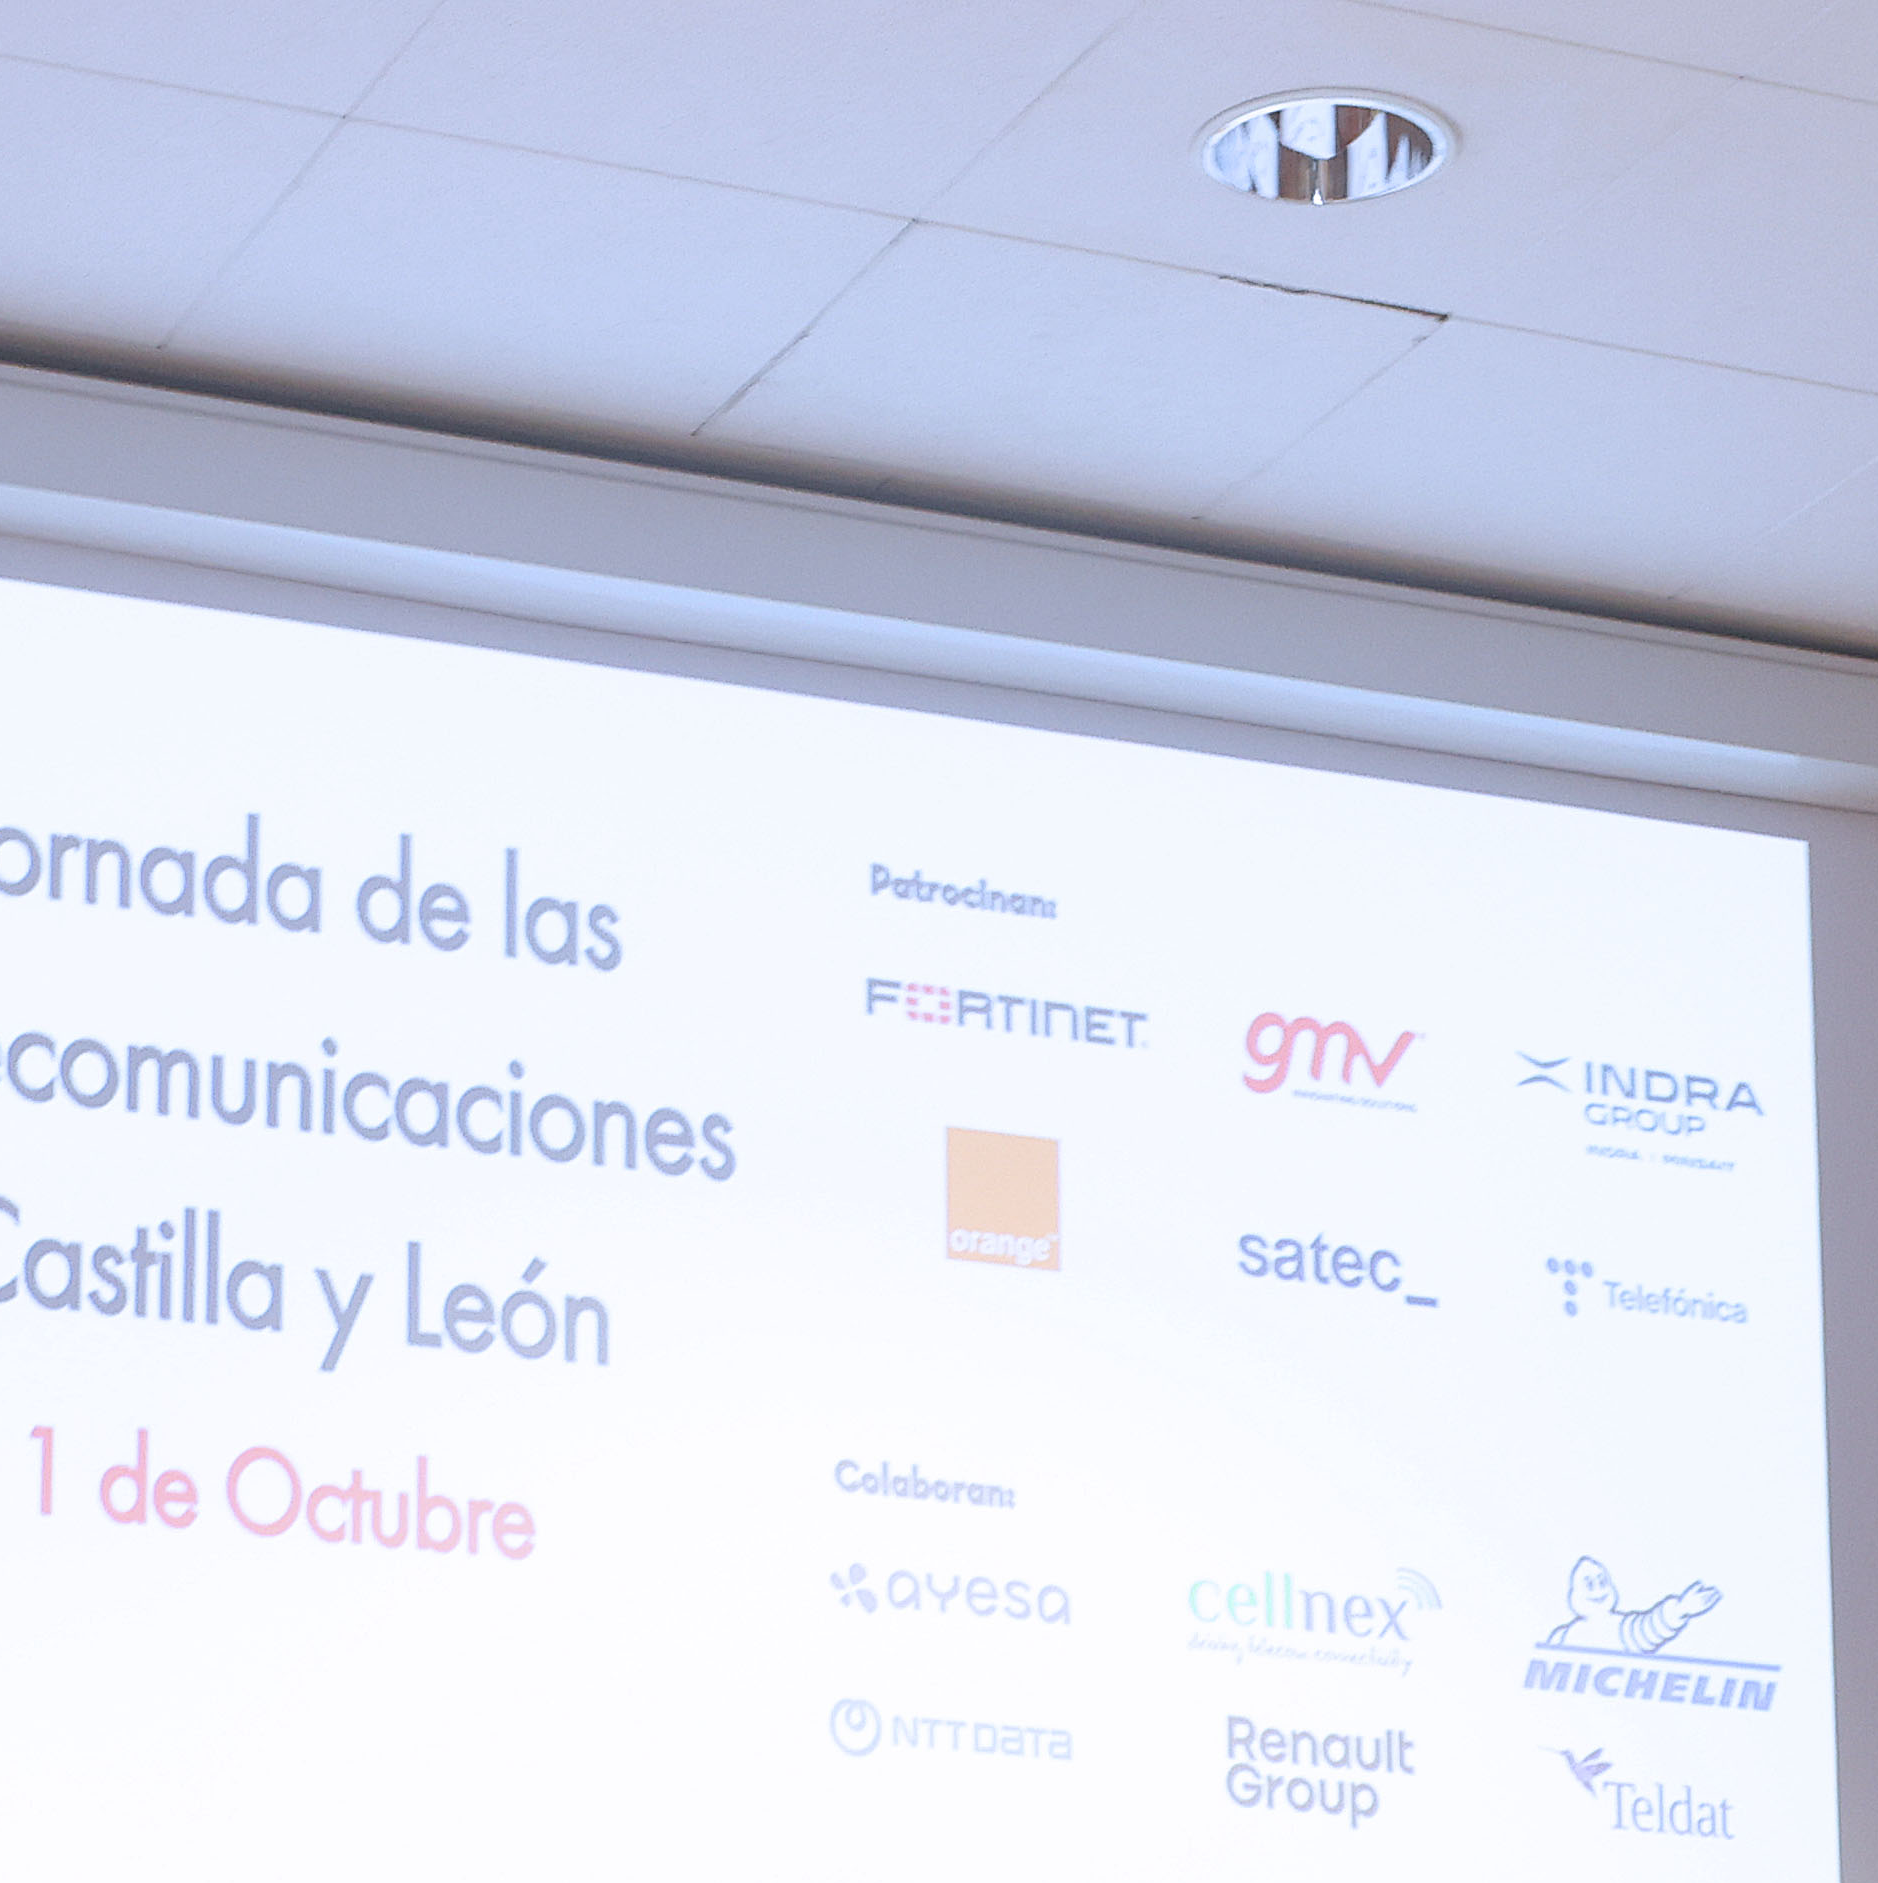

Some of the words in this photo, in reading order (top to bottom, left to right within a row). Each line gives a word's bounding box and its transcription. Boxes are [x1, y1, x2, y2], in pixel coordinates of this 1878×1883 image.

[356, 833, 470, 951] de
[505, 848, 622, 971] las
[870, 863, 1057, 921] Patrocinan:
[865, 978, 1147, 1049] FORTINET
[1243, 1011, 1416, 1094] gmv
[1583, 1060, 1765, 1117] INDRA
[1583, 1101, 1707, 1137] GROUP
[949, 1228, 1051, 1265] orange
[316, 1267, 373, 1371] y
[406, 1241, 609, 1365] León
[1605, 1279, 1749, 1324] Telefónica
[29, 1426, 54, 1515] 1
[100, 1427, 197, 1528] de
[226, 1445, 535, 1560] Octubre
[835, 1459, 1016, 1510] Colaboran:
[887, 1568, 1072, 1625] ayesa
[1187, 1571, 1410, 1642] cellnex
[1523, 1659, 1778, 1712] MICHELIN
[1227, 1715, 1414, 1775] Renault
[1227, 1765, 1379, 1828] Group
[1605, 1781, 1735, 1841] Teldat
